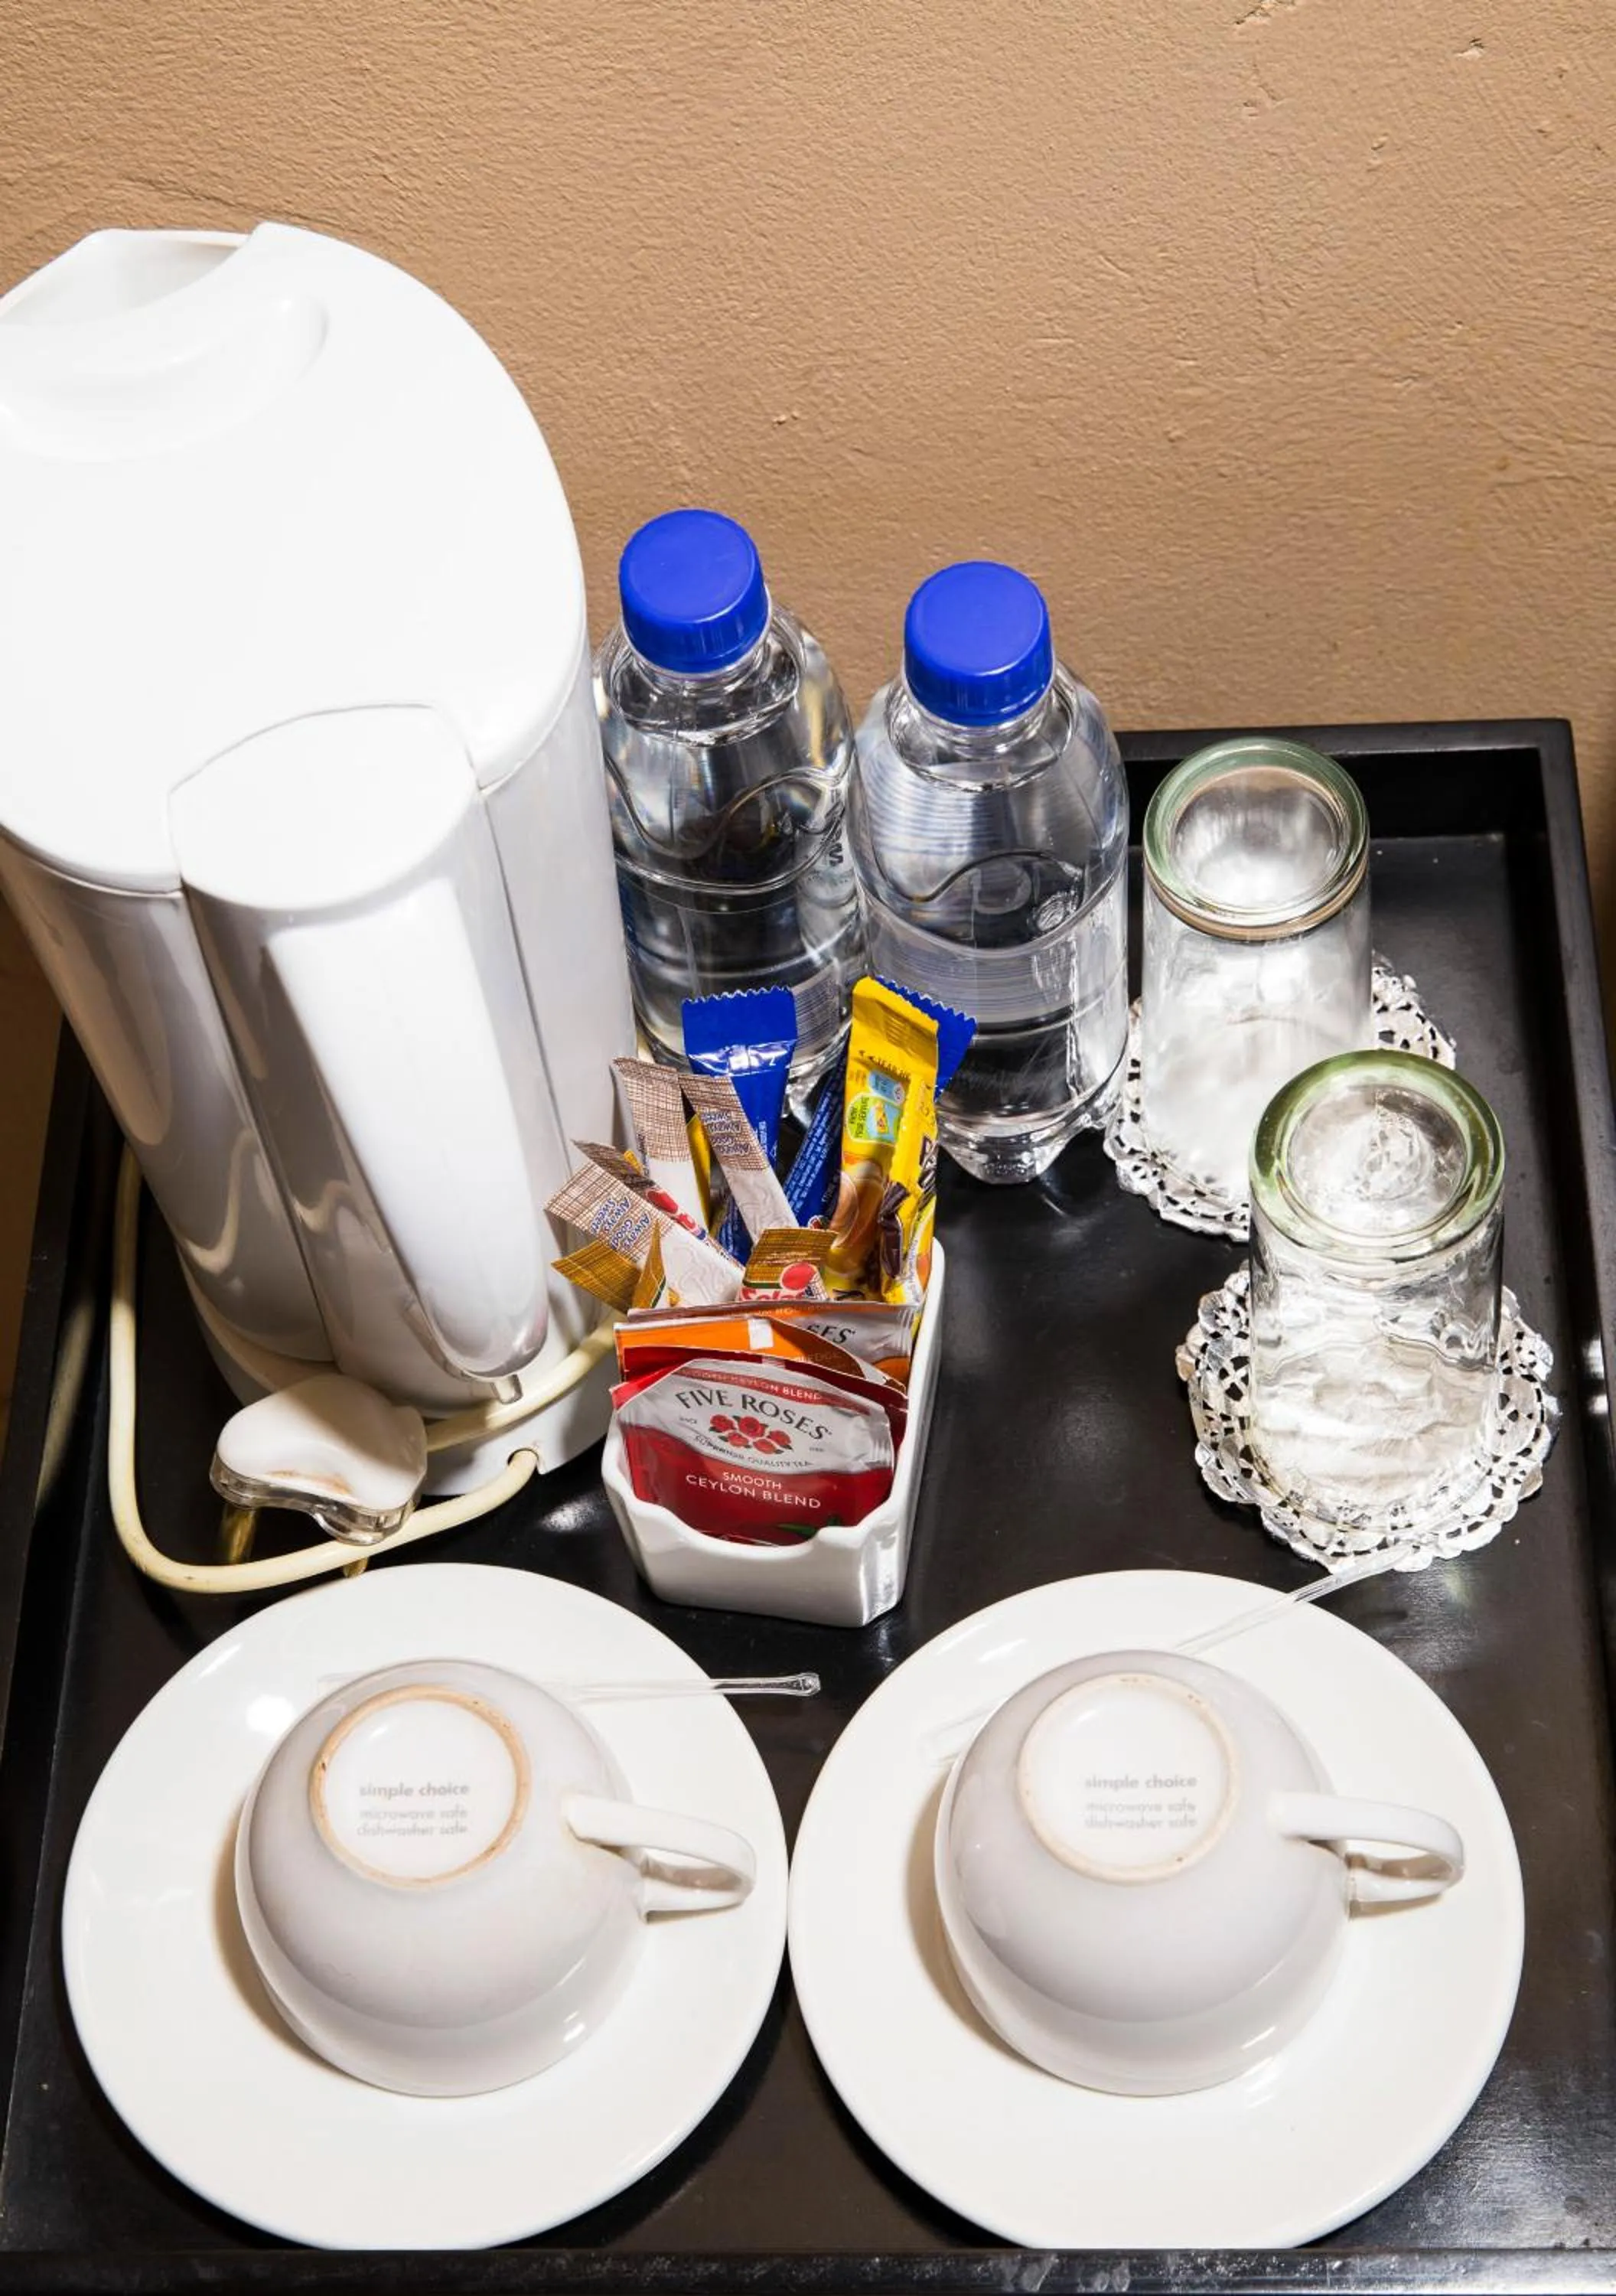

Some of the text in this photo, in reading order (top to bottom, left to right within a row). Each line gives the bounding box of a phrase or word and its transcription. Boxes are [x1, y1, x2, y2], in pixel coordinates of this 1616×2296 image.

[675, 1389, 829, 1441] FIVE ROSES
[723, 1471, 782, 1490] SMOOTH
[686, 1475, 821, 1508] CEYLON BLEND
[360, 1781, 470, 1800] simple choice
[1085, 1773, 1197, 1792] simple choice
